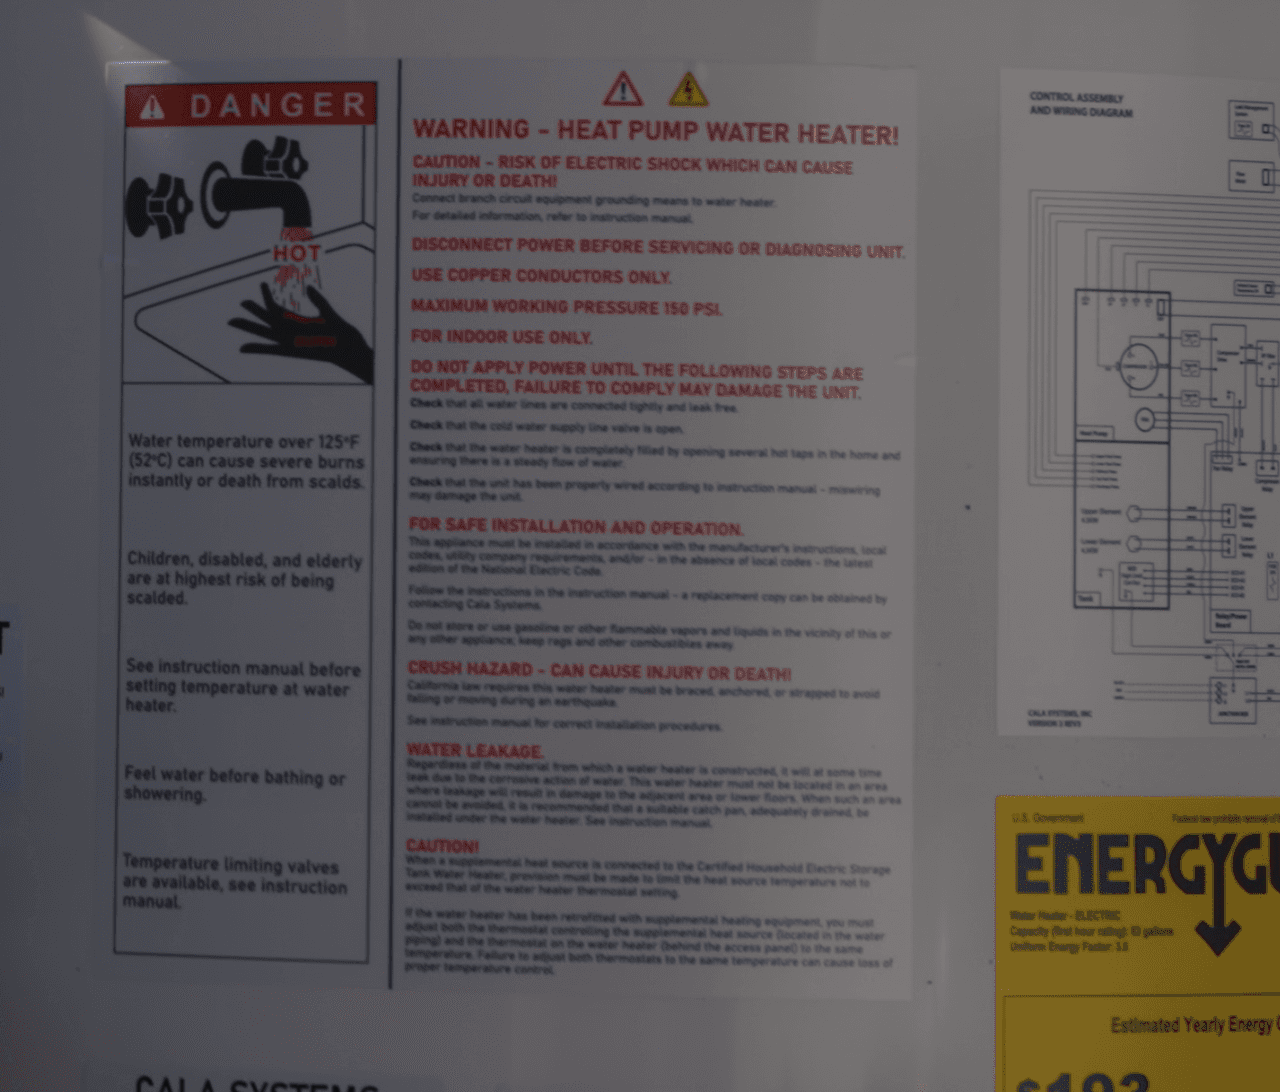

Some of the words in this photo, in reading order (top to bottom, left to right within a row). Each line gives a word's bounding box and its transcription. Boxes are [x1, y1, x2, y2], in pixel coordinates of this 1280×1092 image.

[191, 92, 365, 118] DANGER
[1030, 92, 1074, 102] CONTROL
[1076, 93, 1124, 104] ASSEMBLY
[1030, 106, 1051, 114] AND
[1052, 106, 1087, 116] WIRING
[1090, 108, 1133, 118] DIAGRAM
[413, 118, 529, 138] WARNING
[558, 119, 622, 139] HEAT
[628, 120, 698, 140] PUMP
[706, 121, 789, 142] WATER
[798, 124, 899, 145] HEATER!
[412, 154, 480, 168] CAUTION
[498, 154, 535, 169] RISK
[540, 155, 561, 169] OF
[565, 155, 642, 170] ELECTRIC
[646, 156, 701, 171] SHOCK
[705, 158, 759, 172] WHICH
[763, 159, 797, 173] CAN
[802, 160, 852, 174] CAUSE
[412, 173, 469, 187] INJURY
[472, 173, 495, 187] OR
[499, 173, 558, 188] DEATH!
[272, 244, 321, 262] HOT
[411, 236, 513, 251] DISCONNECT
[516, 237, 575, 252] POWER
[579, 238, 643, 253] BEFORE
[648, 239, 733, 254] SERVICING
[738, 241, 760, 255] OR
[765, 242, 861, 257] DIAGNOSING
[866, 245, 904, 258] UNIT.
[411, 267, 442, 282] USE
[447, 267, 511, 282] COPPER
[515, 268, 623, 283] CONDUCTORS
[627, 270, 672, 284] ONLY.
[410, 298, 488, 312] MAXIMUM
[492, 299, 568, 313] WORKING
[573, 300, 659, 315] PRESSURE
[663, 301, 689, 315] 150
[693, 302, 723, 316] PSI.
[410, 328, 442, 342] FOR
[446, 329, 508, 343] INDOOR
[512, 329, 544, 344] USE
[548, 330, 593, 344] ONLY.
[410, 359, 433, 373] DO
[436, 359, 469, 373] NOT
[472, 360, 524, 374] APPLY
[528, 360, 586, 375] POWER
[590, 362, 638, 376] UNTIL
[642, 362, 673, 377] THE
[678, 363, 772, 378] FOLLOWING
[777, 365, 826, 380] STEPS
[832, 366, 862, 380] ARE
[410, 378, 510, 394] COMPLETED,
[514, 379, 581, 394] FAILURE
[585, 380, 606, 394] TO
[610, 380, 674, 395] COMPLY
[678, 382, 712, 396] MAY
[715, 383, 782, 398] DAMAGE
[786, 384, 816, 399] THE
[822, 385, 861, 399] UNIT.
[128, 433, 172, 448] Water
[176, 435, 273, 450] temperature
[278, 437, 314, 449] over
[177, 456, 204, 467] can
[208, 456, 254, 468] cause
[259, 456, 312, 469] severe
[318, 455, 364, 469] burns
[128, 473, 192, 489] instantly
[196, 476, 213, 487] or
[218, 473, 261, 488] death
[266, 473, 303, 488] from
[308, 475, 365, 489] scalds.
[409, 516, 440, 531] FOR
[445, 517, 486, 532] SAFE
[491, 518, 606, 533] INSTALLATION
[610, 520, 645, 534] AND
[650, 521, 745, 536] OPERATION.
[127, 550, 195, 567] Children,
[198, 551, 268, 568] disabled,
[272, 553, 301, 567] and
[306, 553, 362, 571] elderly
[127, 573, 151, 585] are
[156, 571, 170, 585] at
[174, 571, 230, 589] highest
[235, 572, 266, 586] risk
[270, 572, 286, 587] of
[290, 573, 334, 591] being
[127, 590, 188, 605] scalded.
[126, 657, 153, 673] See
[158, 660, 240, 674] instruction
[245, 662, 304, 676] manual
[309, 662, 361, 677] before
[407, 660, 462, 675] CRUSH
[466, 661, 533, 676] HAZARD
[550, 662, 584, 677] CAN
[588, 664, 641, 678] CAUSE
[646, 665, 703, 679] INJURY
[707, 666, 729, 680] OR
[734, 666, 792, 681] DEATH!
[126, 679, 176, 696] setting
[180, 680, 278, 696] temperature
[282, 682, 297, 696] at
[303, 683, 350, 697] water
[125, 697, 177, 712] heater.
[406, 742, 461, 760] WATER
[466, 743, 545, 759] LEAKAGE.
[124, 764, 156, 780] Feel
[160, 768, 204, 782] water
[209, 768, 259, 783] before
[264, 770, 323, 788] bathing
[328, 774, 346, 786] or
[124, 785, 207, 805] showering.
[406, 838, 480, 853] CAUTION!
[122, 852, 219, 871] Temperature
[224, 857, 282, 876] limiting
[287, 859, 339, 875] valves
[122, 875, 147, 888] are
[152, 875, 224, 891] available,
[228, 879, 256, 892] see
[260, 879, 347, 894] instruction
[122, 895, 182, 909] manual.
[1111, 1016, 1180, 1034] Estimated
[1183, 1016, 1226, 1037] Yearly
[1228, 1015, 1273, 1036] Energy
